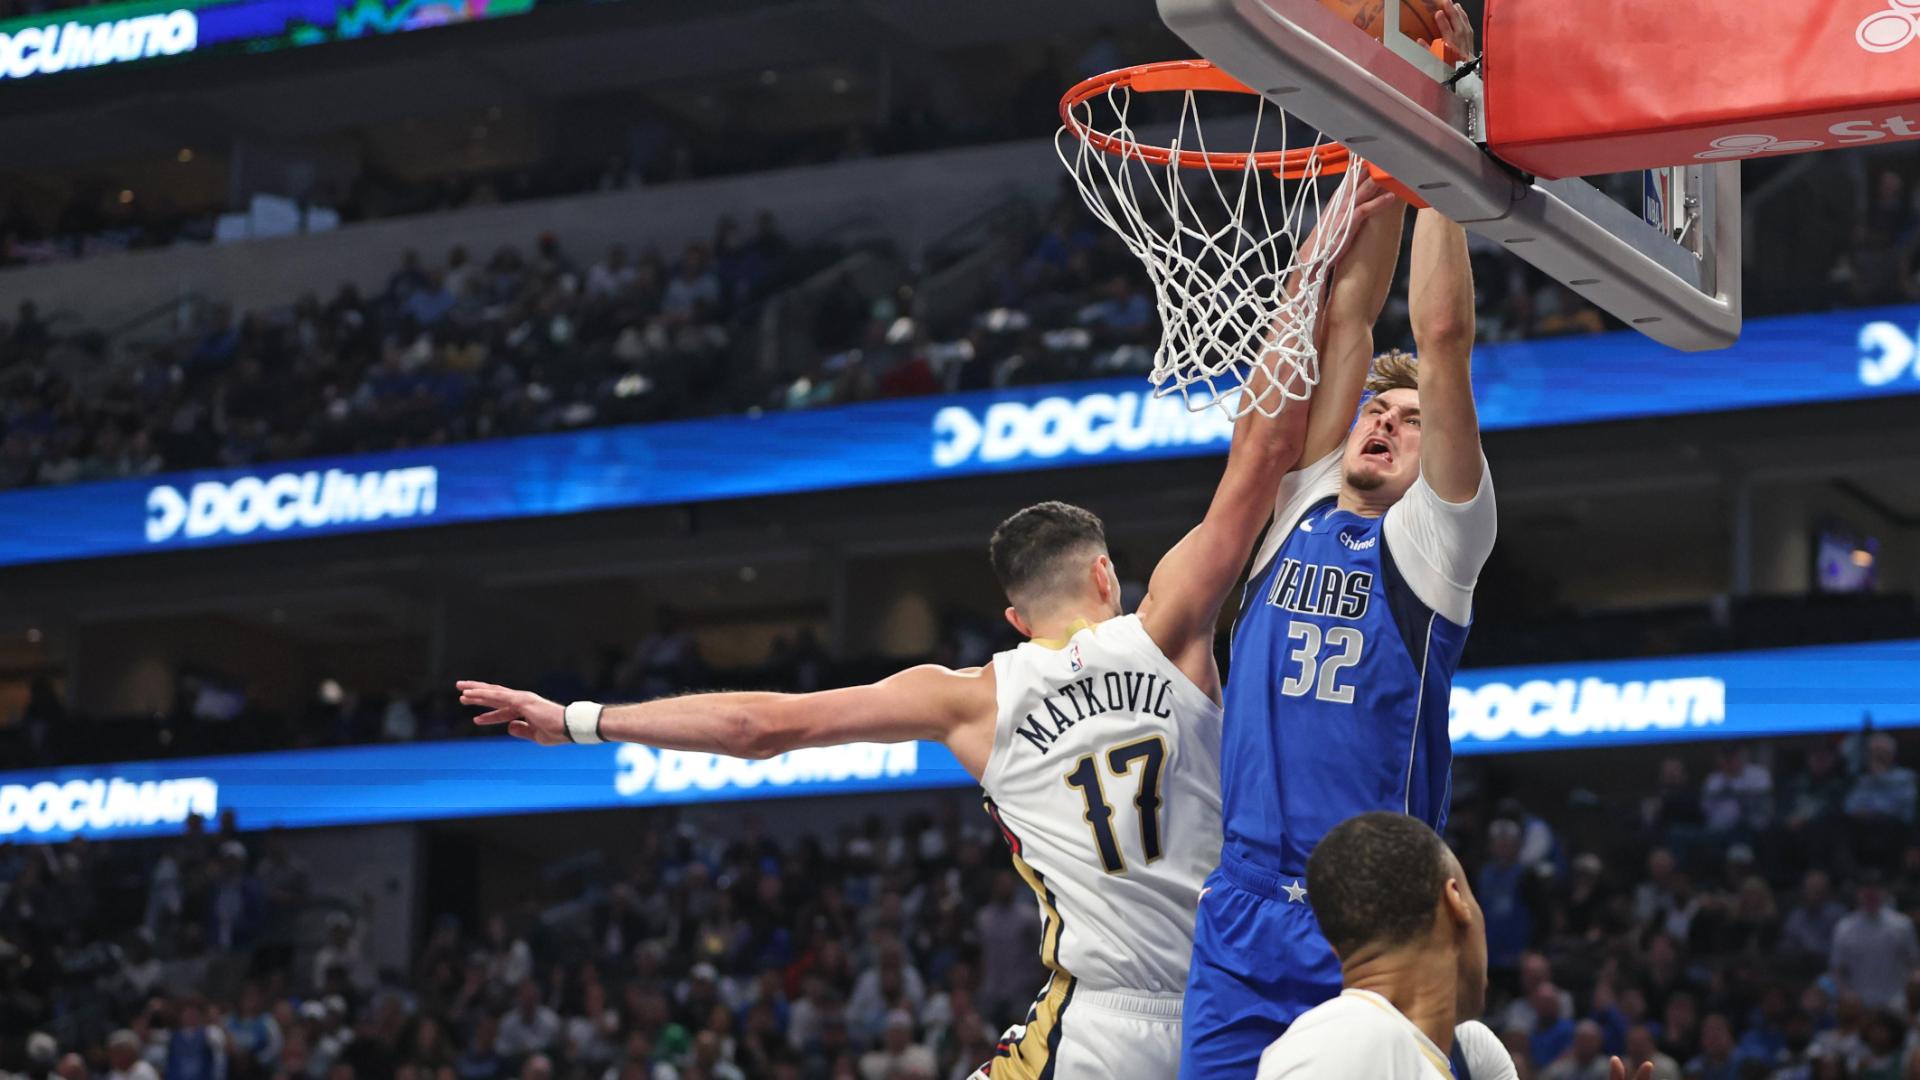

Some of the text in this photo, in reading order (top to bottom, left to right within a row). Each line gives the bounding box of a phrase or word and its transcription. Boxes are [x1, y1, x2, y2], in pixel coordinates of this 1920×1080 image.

[1340, 532, 1376, 551] chime
[1281, 620, 1364, 704] 32
[1064, 734, 1168, 876] 17
